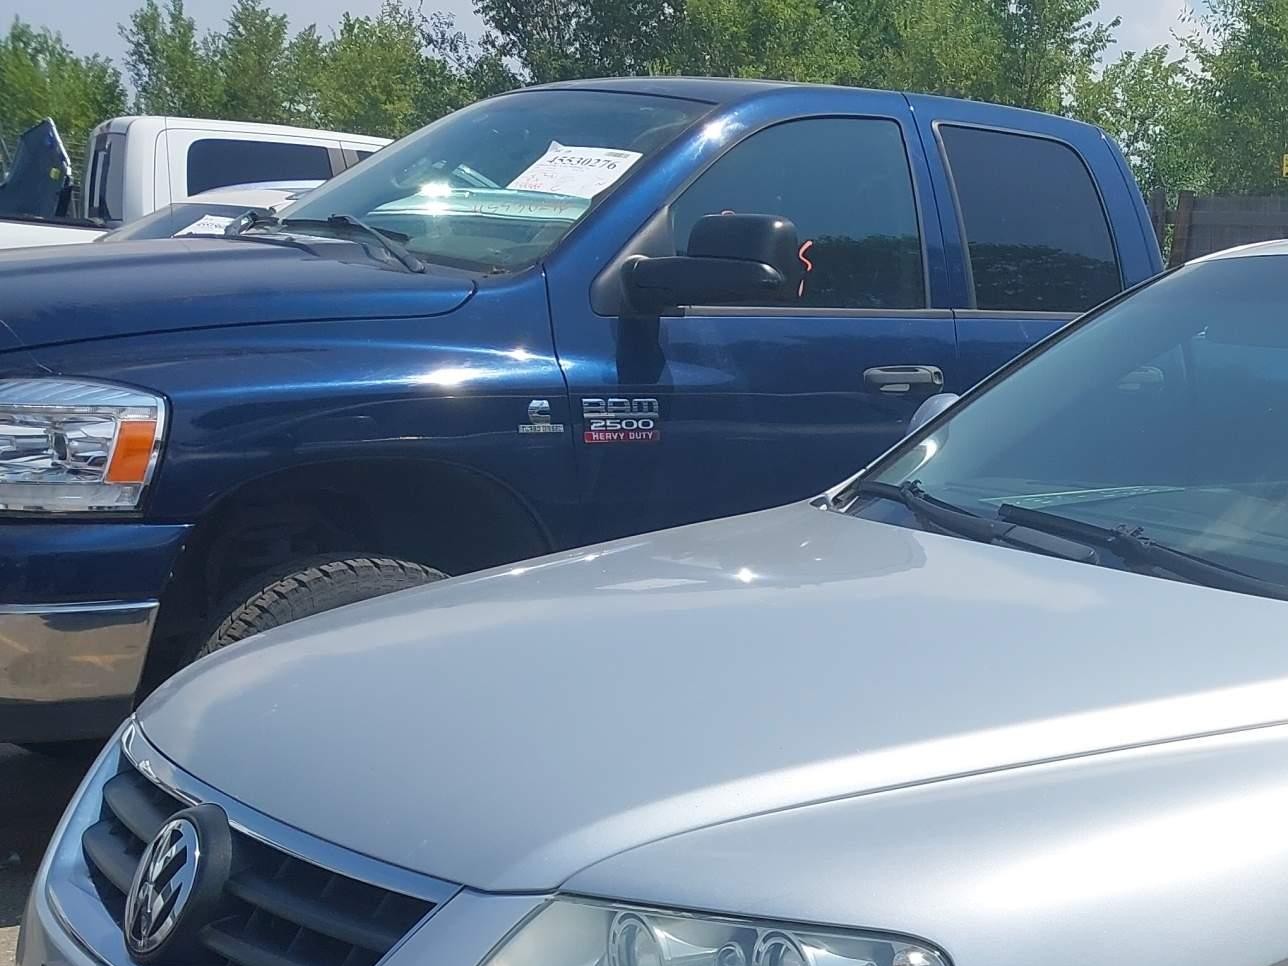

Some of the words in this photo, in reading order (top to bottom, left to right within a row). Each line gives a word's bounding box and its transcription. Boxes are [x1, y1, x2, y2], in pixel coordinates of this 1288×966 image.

[546, 155, 617, 170] 45530276
[581, 398, 660, 418] RAM
[590, 419, 654, 430] 2500
[592, 431, 625, 440] HEAVY
[629, 431, 653, 440] DUTY
